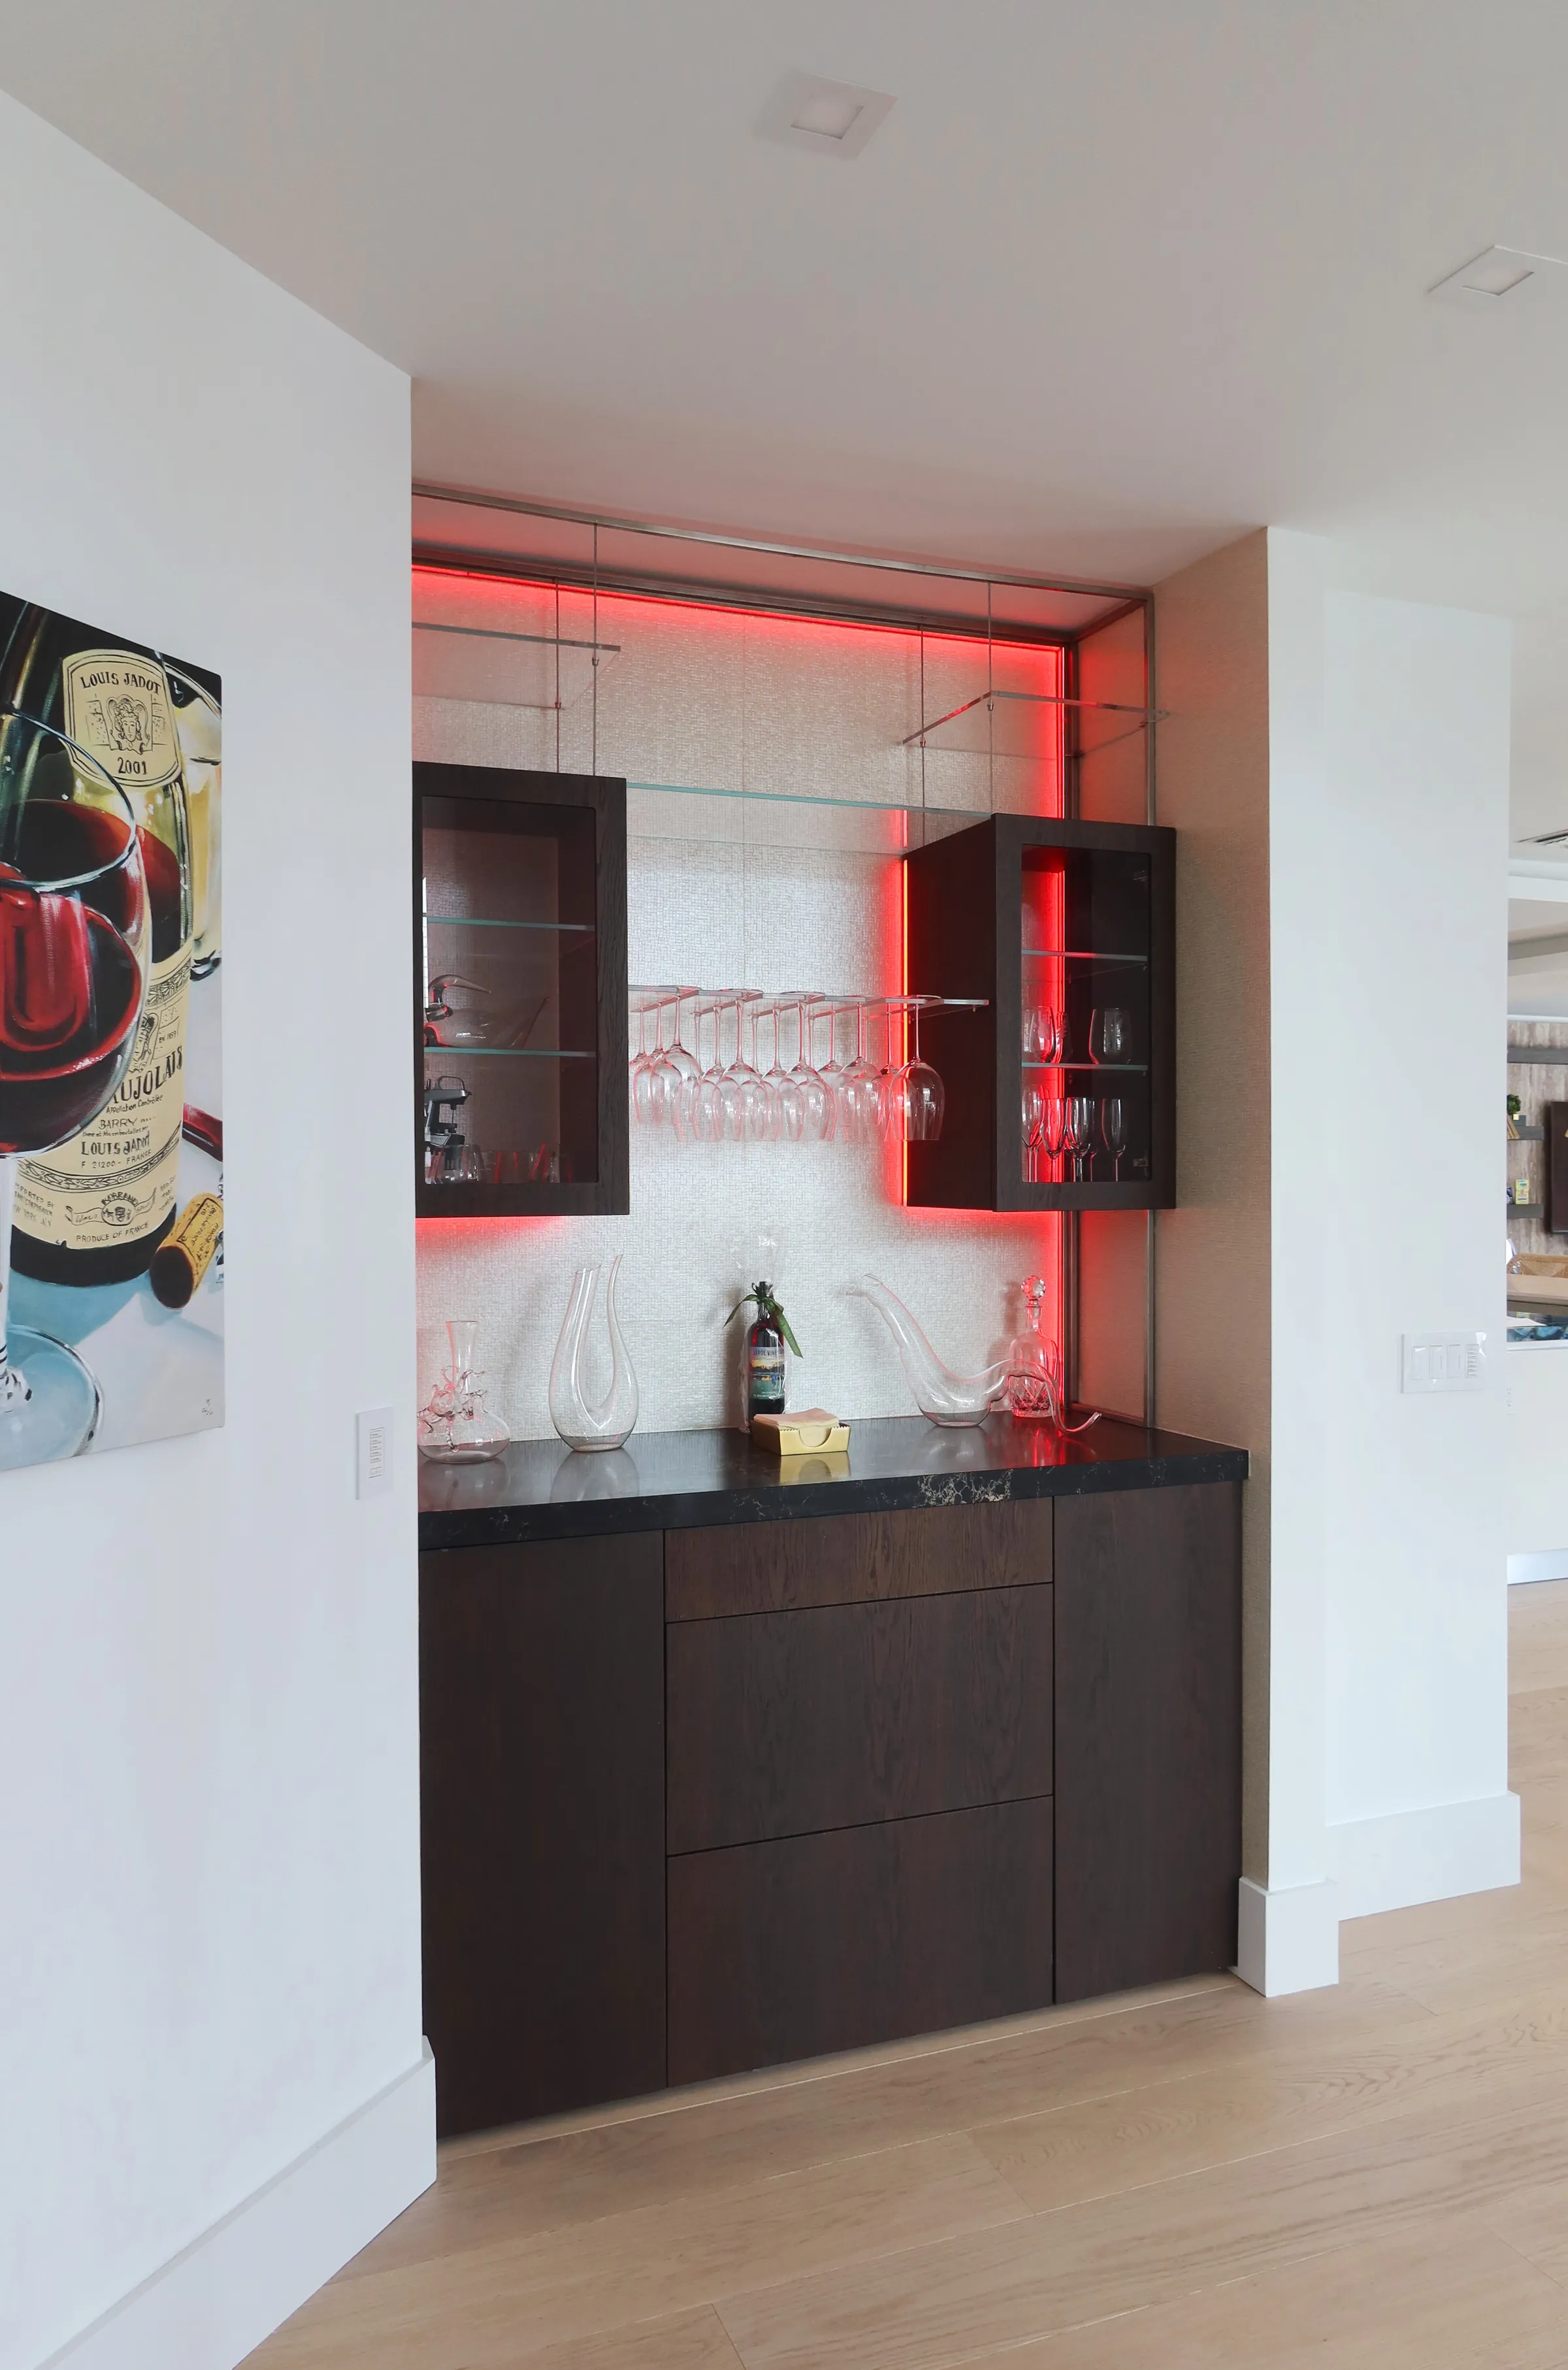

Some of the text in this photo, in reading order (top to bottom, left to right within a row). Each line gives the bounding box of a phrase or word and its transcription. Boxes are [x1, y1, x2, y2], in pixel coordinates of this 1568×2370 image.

[80, 671, 161, 695] LOUIS JADOT
[118, 757, 148, 775] 2001
[159, 1030, 176, 1044] EN 1859
[98, 1117, 138, 1130] BARRY
[81, 1141, 120, 1155] LOUIS
[127, 1149, 152, 1164] FRANCE
[76, 1222, 149, 1242] PRODUCE OF FRANCE
